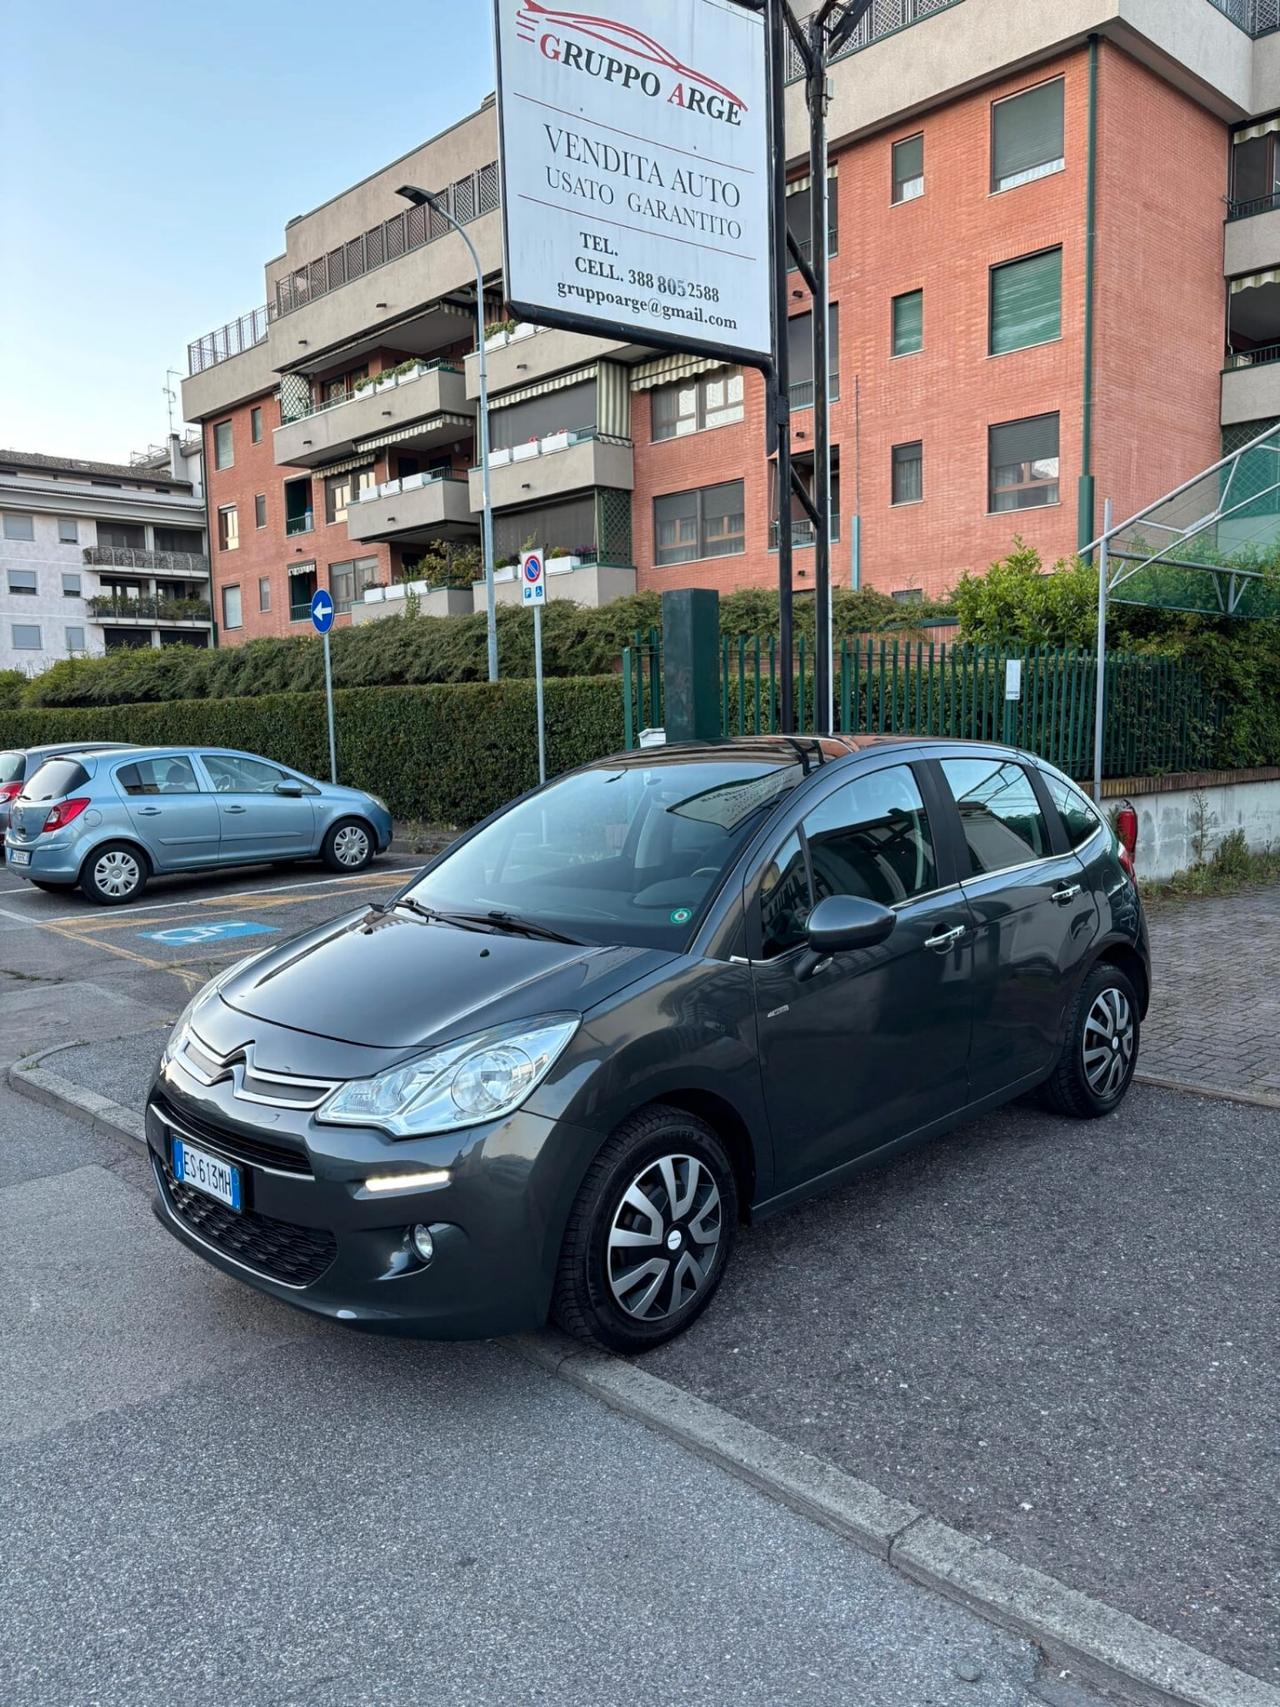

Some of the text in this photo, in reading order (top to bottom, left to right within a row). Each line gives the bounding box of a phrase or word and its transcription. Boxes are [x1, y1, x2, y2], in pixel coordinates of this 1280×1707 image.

[540, 33, 742, 126] GRUPPO ARGE
[543, 123, 740, 208] VENDITA AUTO
[545, 165, 741, 240] USATO GARANTITO
[575, 256, 624, 282] CELL.
[579, 232, 618, 256] TEL.
[557, 281, 737, 329] gruppoarge@gmail.com
